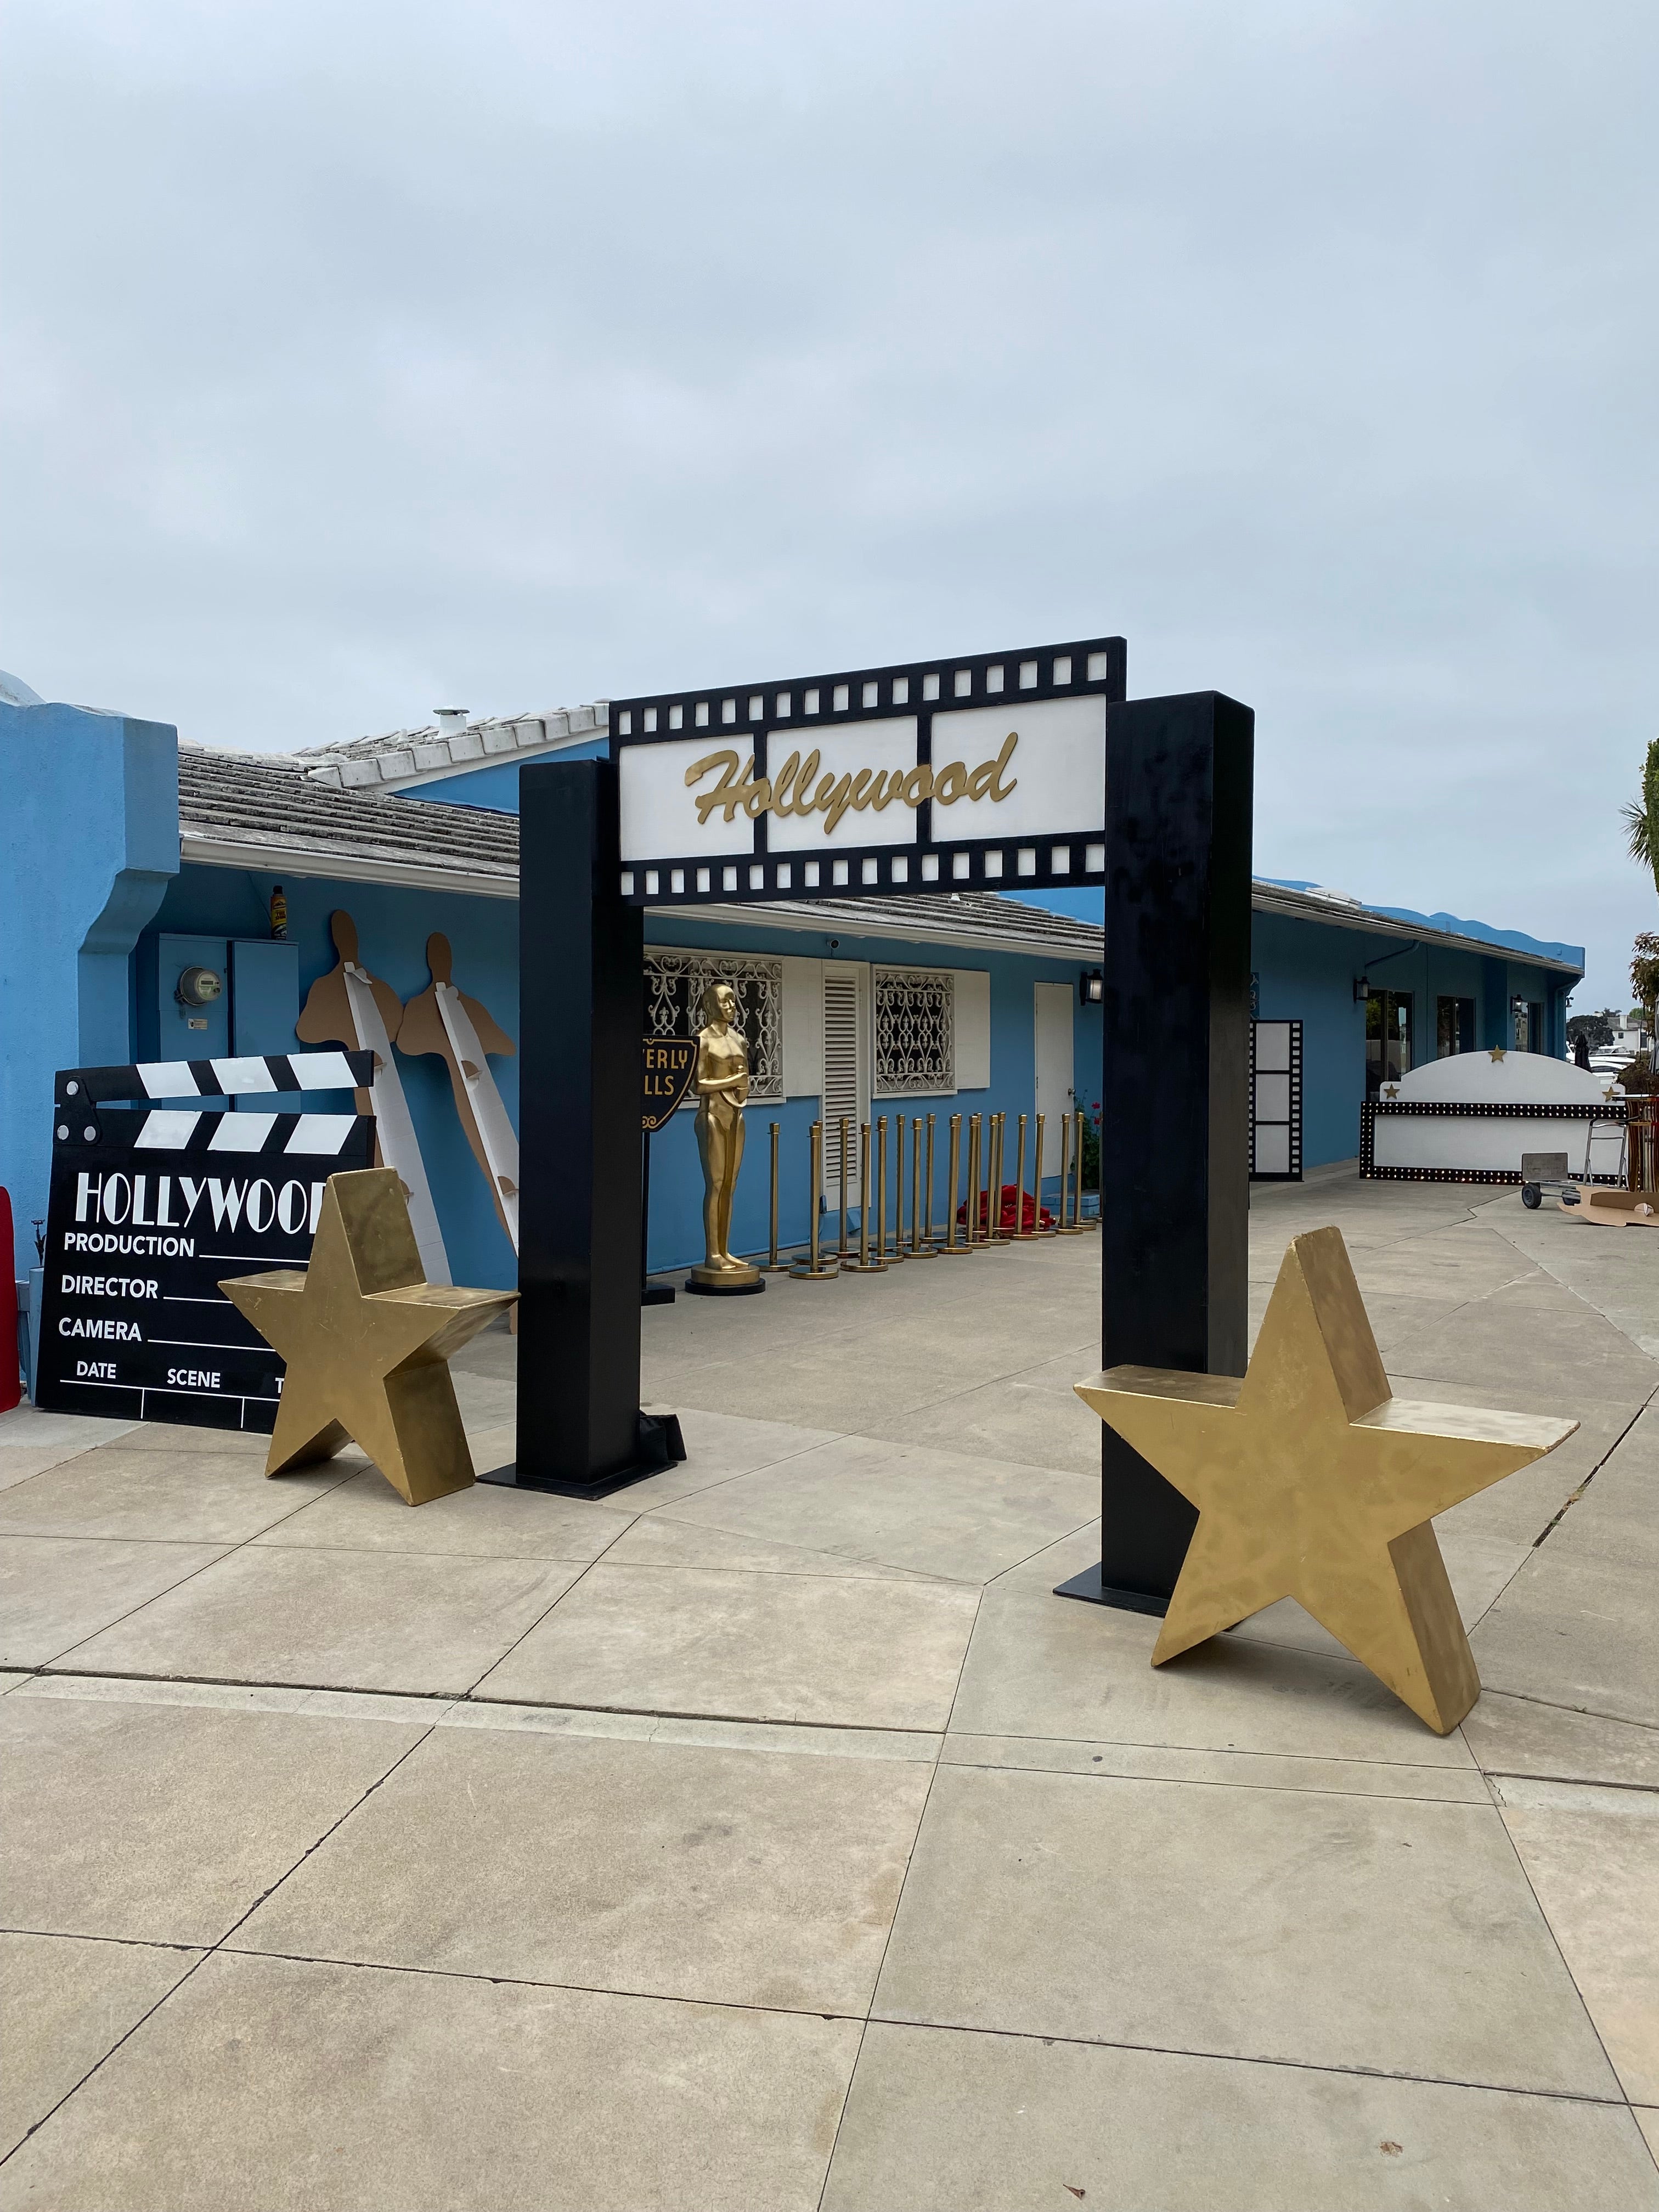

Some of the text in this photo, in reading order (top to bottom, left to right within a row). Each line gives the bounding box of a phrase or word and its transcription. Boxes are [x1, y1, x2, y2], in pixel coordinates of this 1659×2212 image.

[685, 731, 1018, 834] Hollywood
[643, 1048, 688, 1069] ERLY
[644, 1075, 674, 1096] LLS
[64, 1232, 195, 1257] PRODUCTION
[61, 1274, 159, 1299] DIRECTOR
[58, 1317, 142, 1342] CAMERA
[76, 1361, 221, 1388] DATE SCENE
